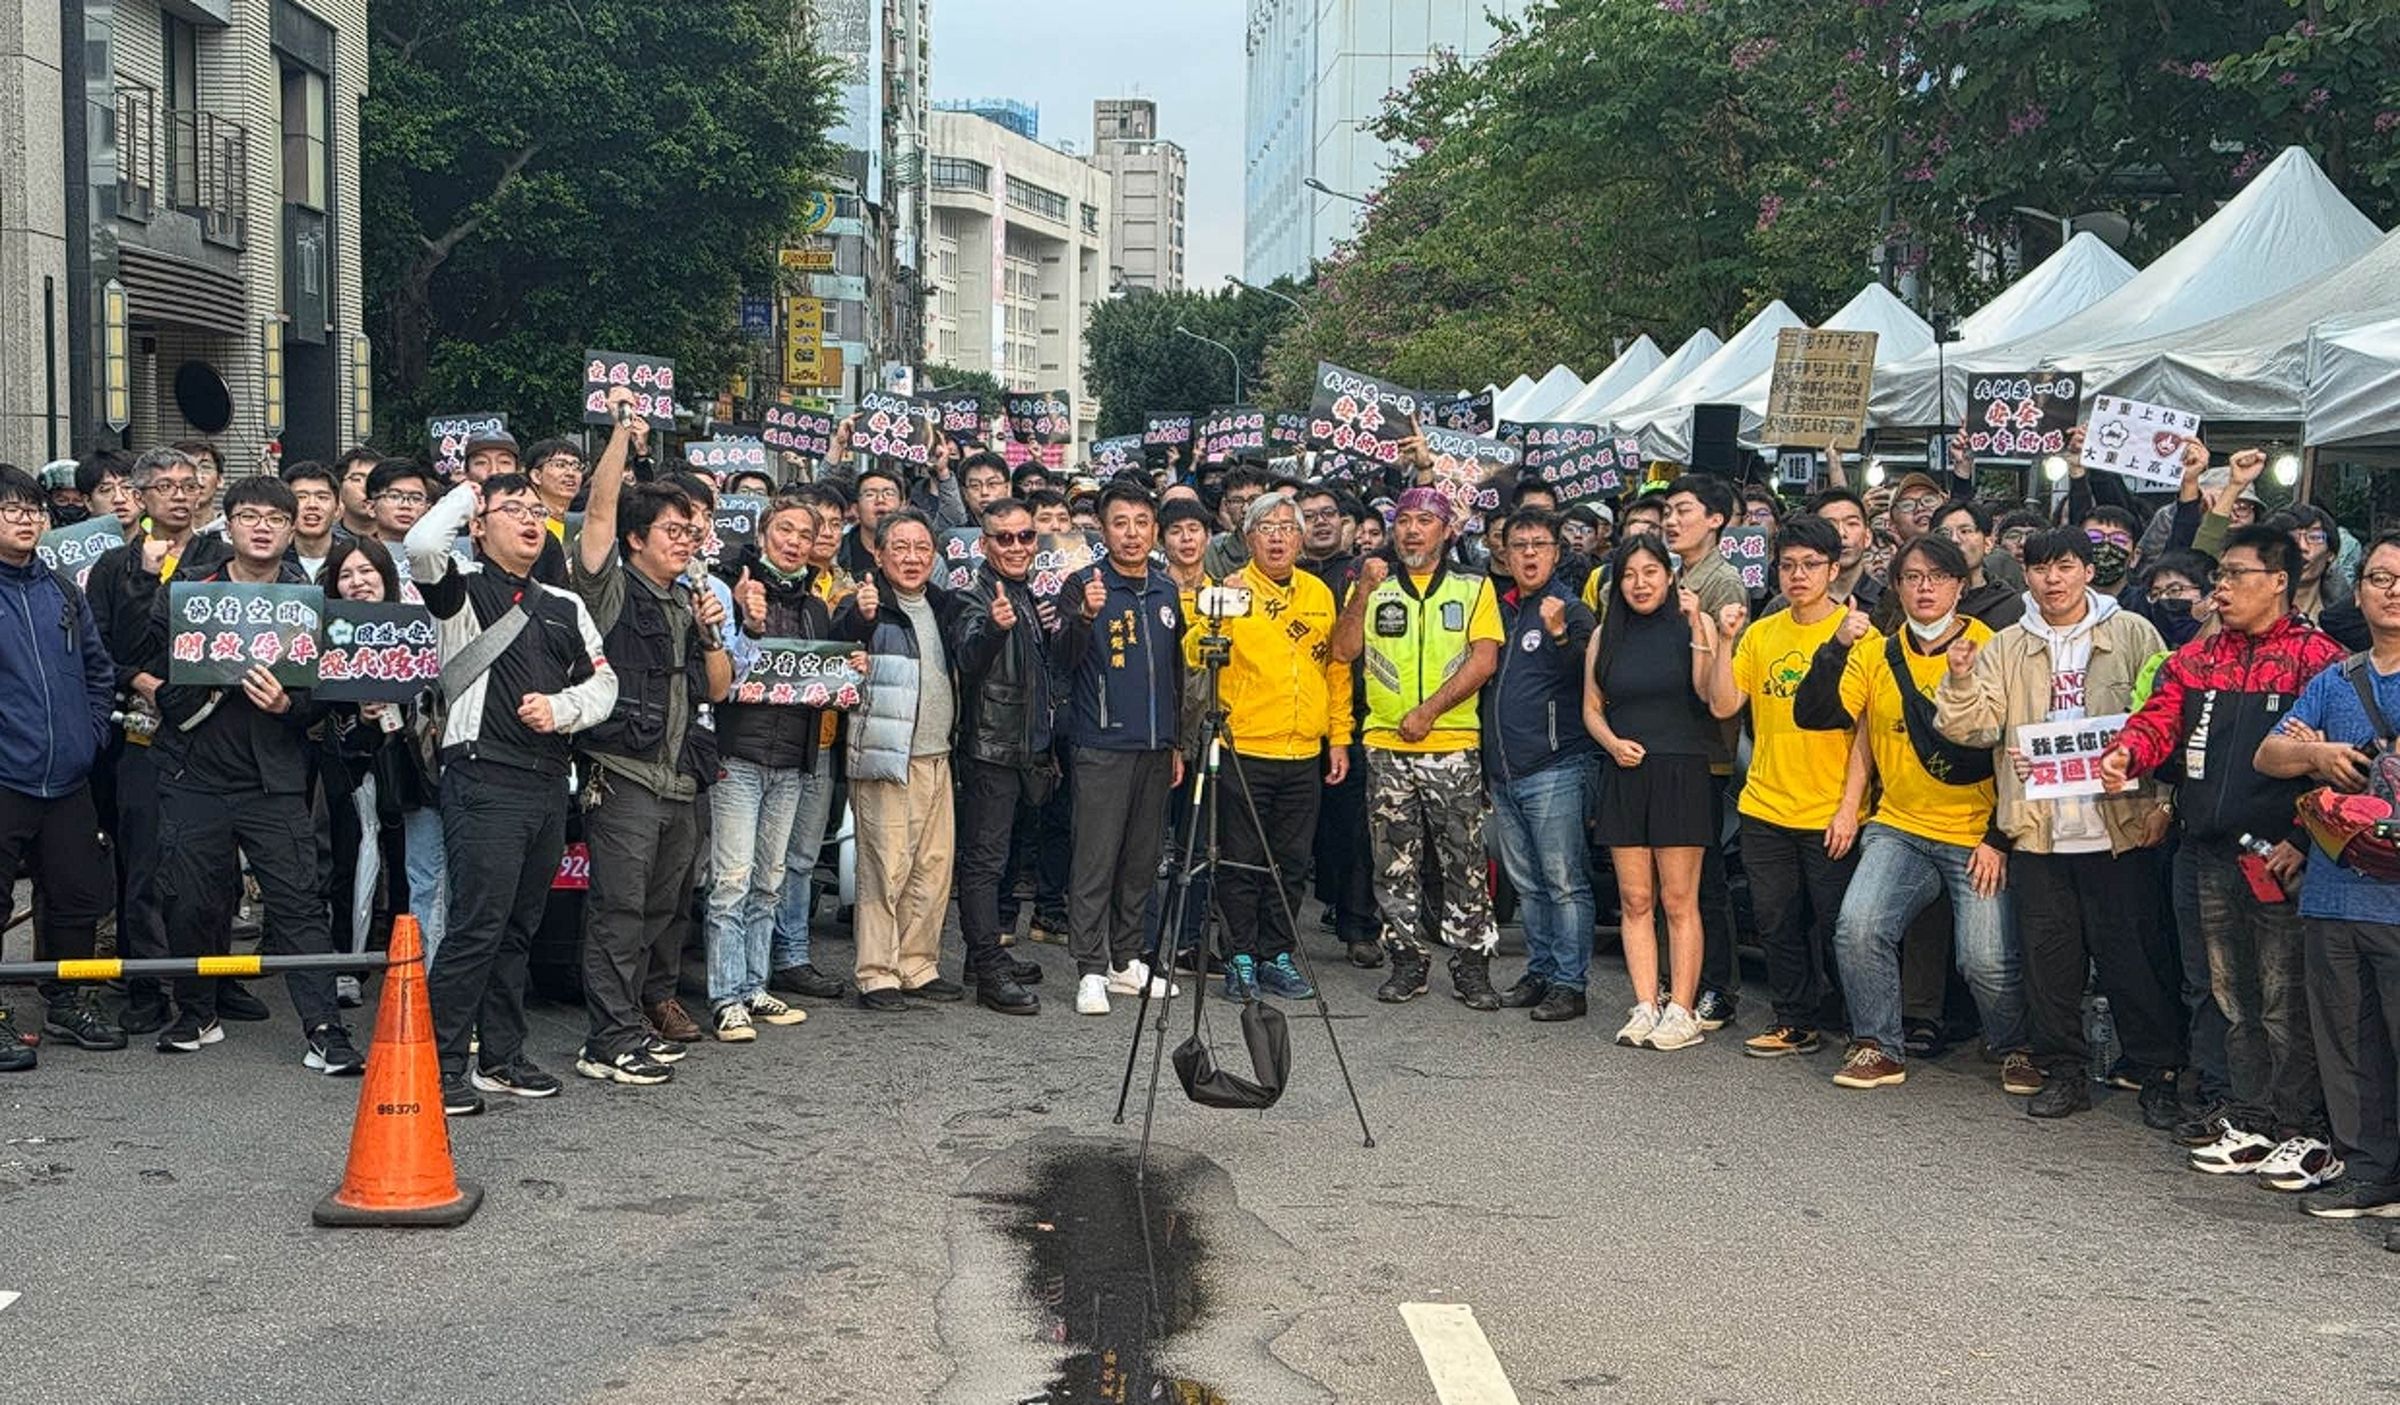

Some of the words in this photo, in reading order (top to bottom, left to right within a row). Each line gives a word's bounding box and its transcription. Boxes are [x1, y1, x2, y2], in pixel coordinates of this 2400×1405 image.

[1974, 379, 2075, 400] 我們要一條
[868, 411, 914, 439] 安全
[1332, 395, 1385, 432] 安全
[1985, 399, 2043, 428] 安全
[1433, 453, 1484, 482] 安全
[2084, 446, 2182, 479] 大重上高速
[184, 596, 302, 625] 節省空間
[174, 631, 319, 665] 開放停車
